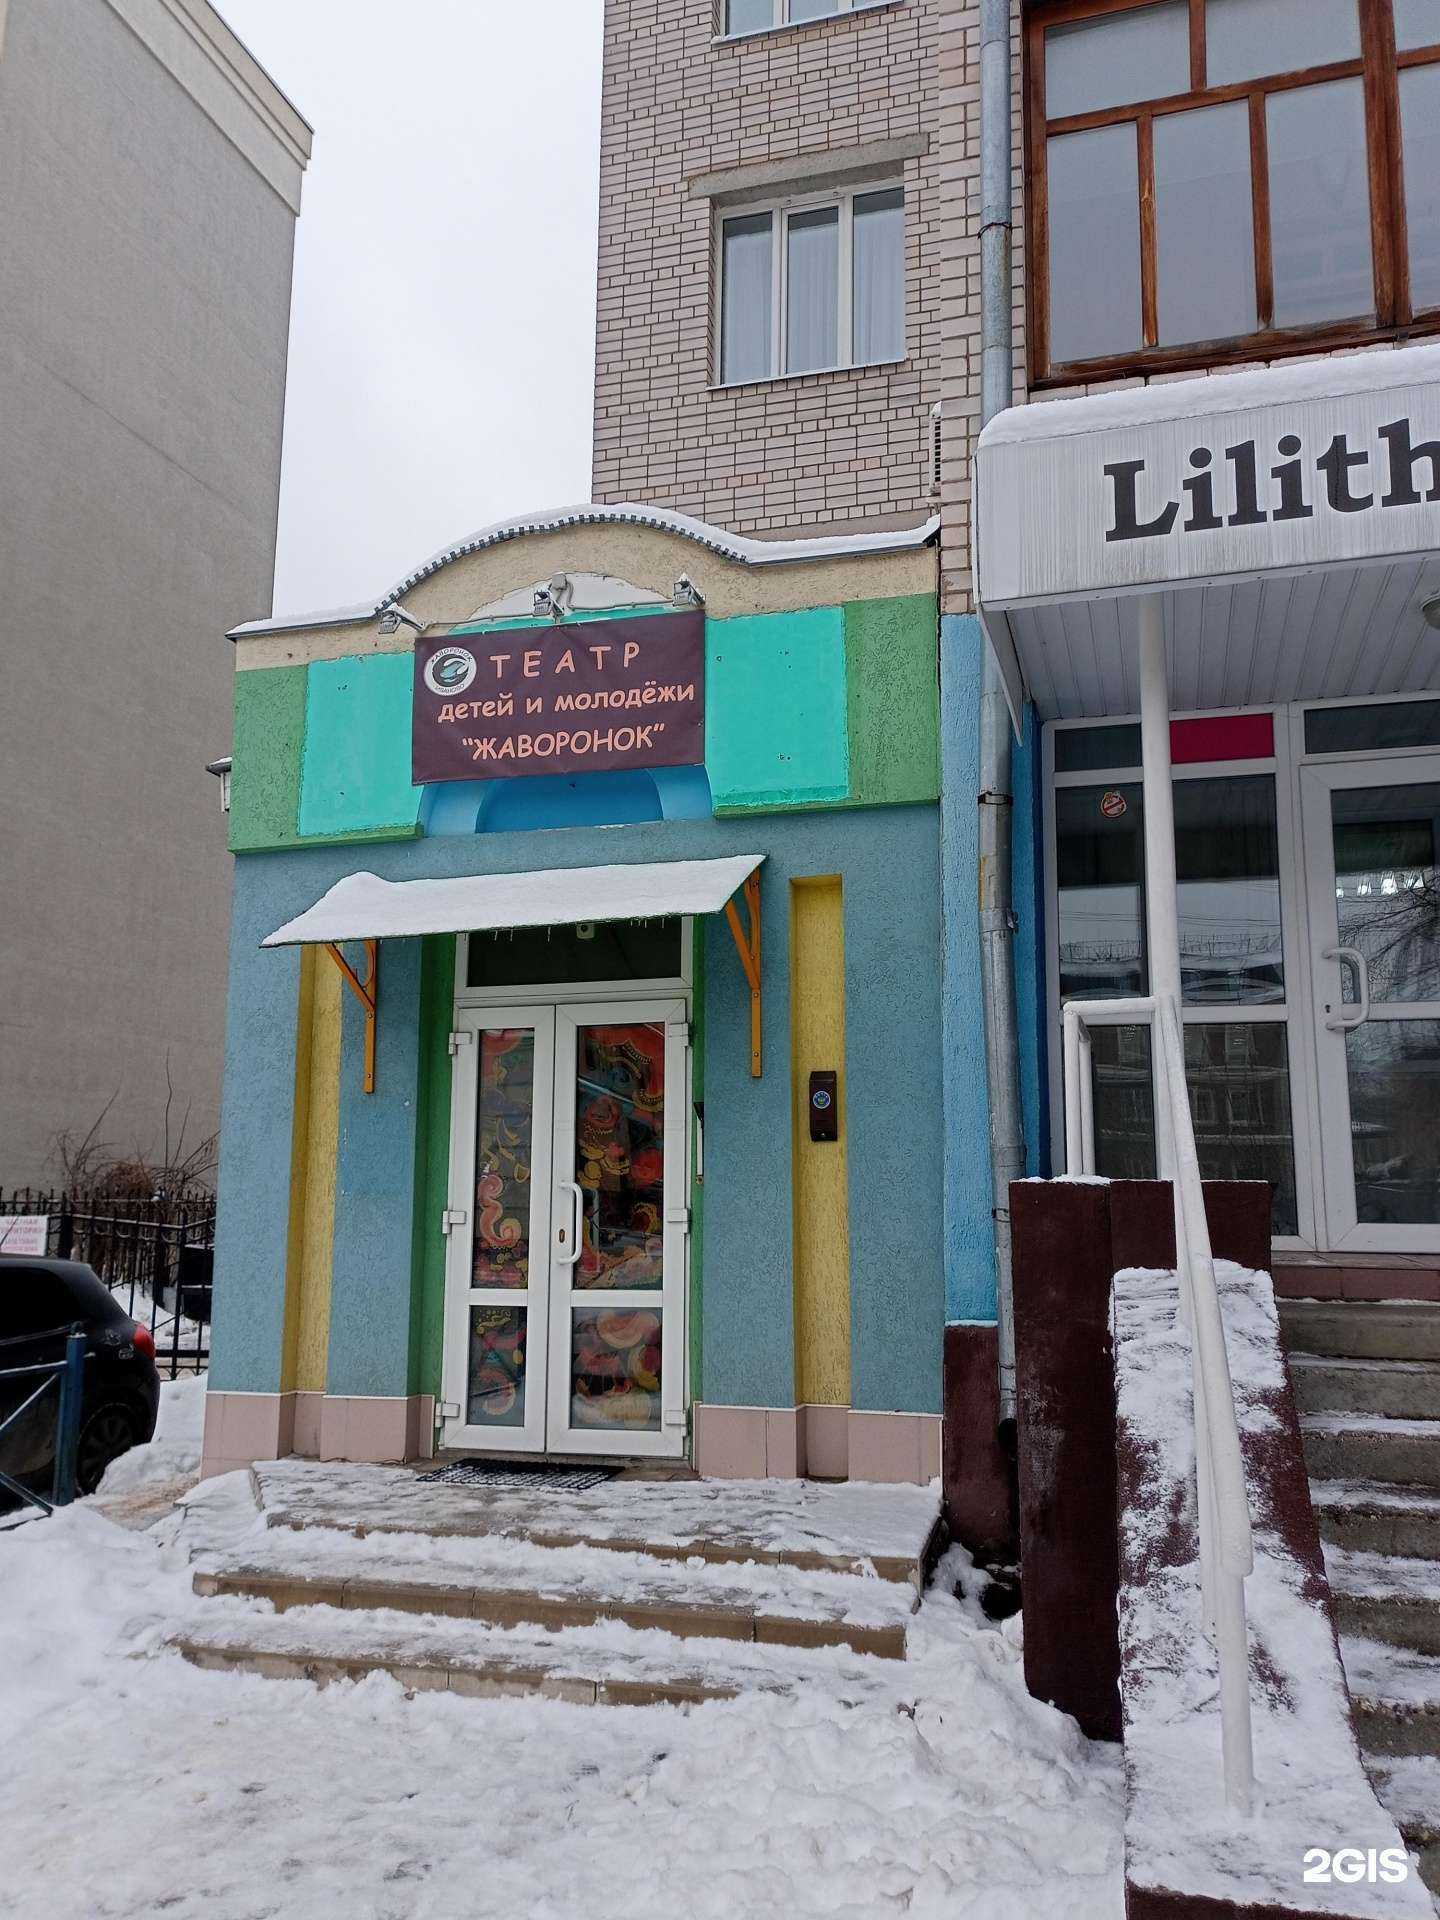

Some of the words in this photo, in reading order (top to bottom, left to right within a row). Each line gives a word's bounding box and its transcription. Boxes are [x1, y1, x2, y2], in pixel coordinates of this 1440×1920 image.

[1104, 418, 1440, 542] Lilith
[490, 642, 640, 678] ТЕАТР
[437, 693, 513, 723] детей
[526, 696, 543, 713] и
[555, 681, 694, 711] молодёжи
[463, 723, 665, 760] "ЖАВОРОНОК"
